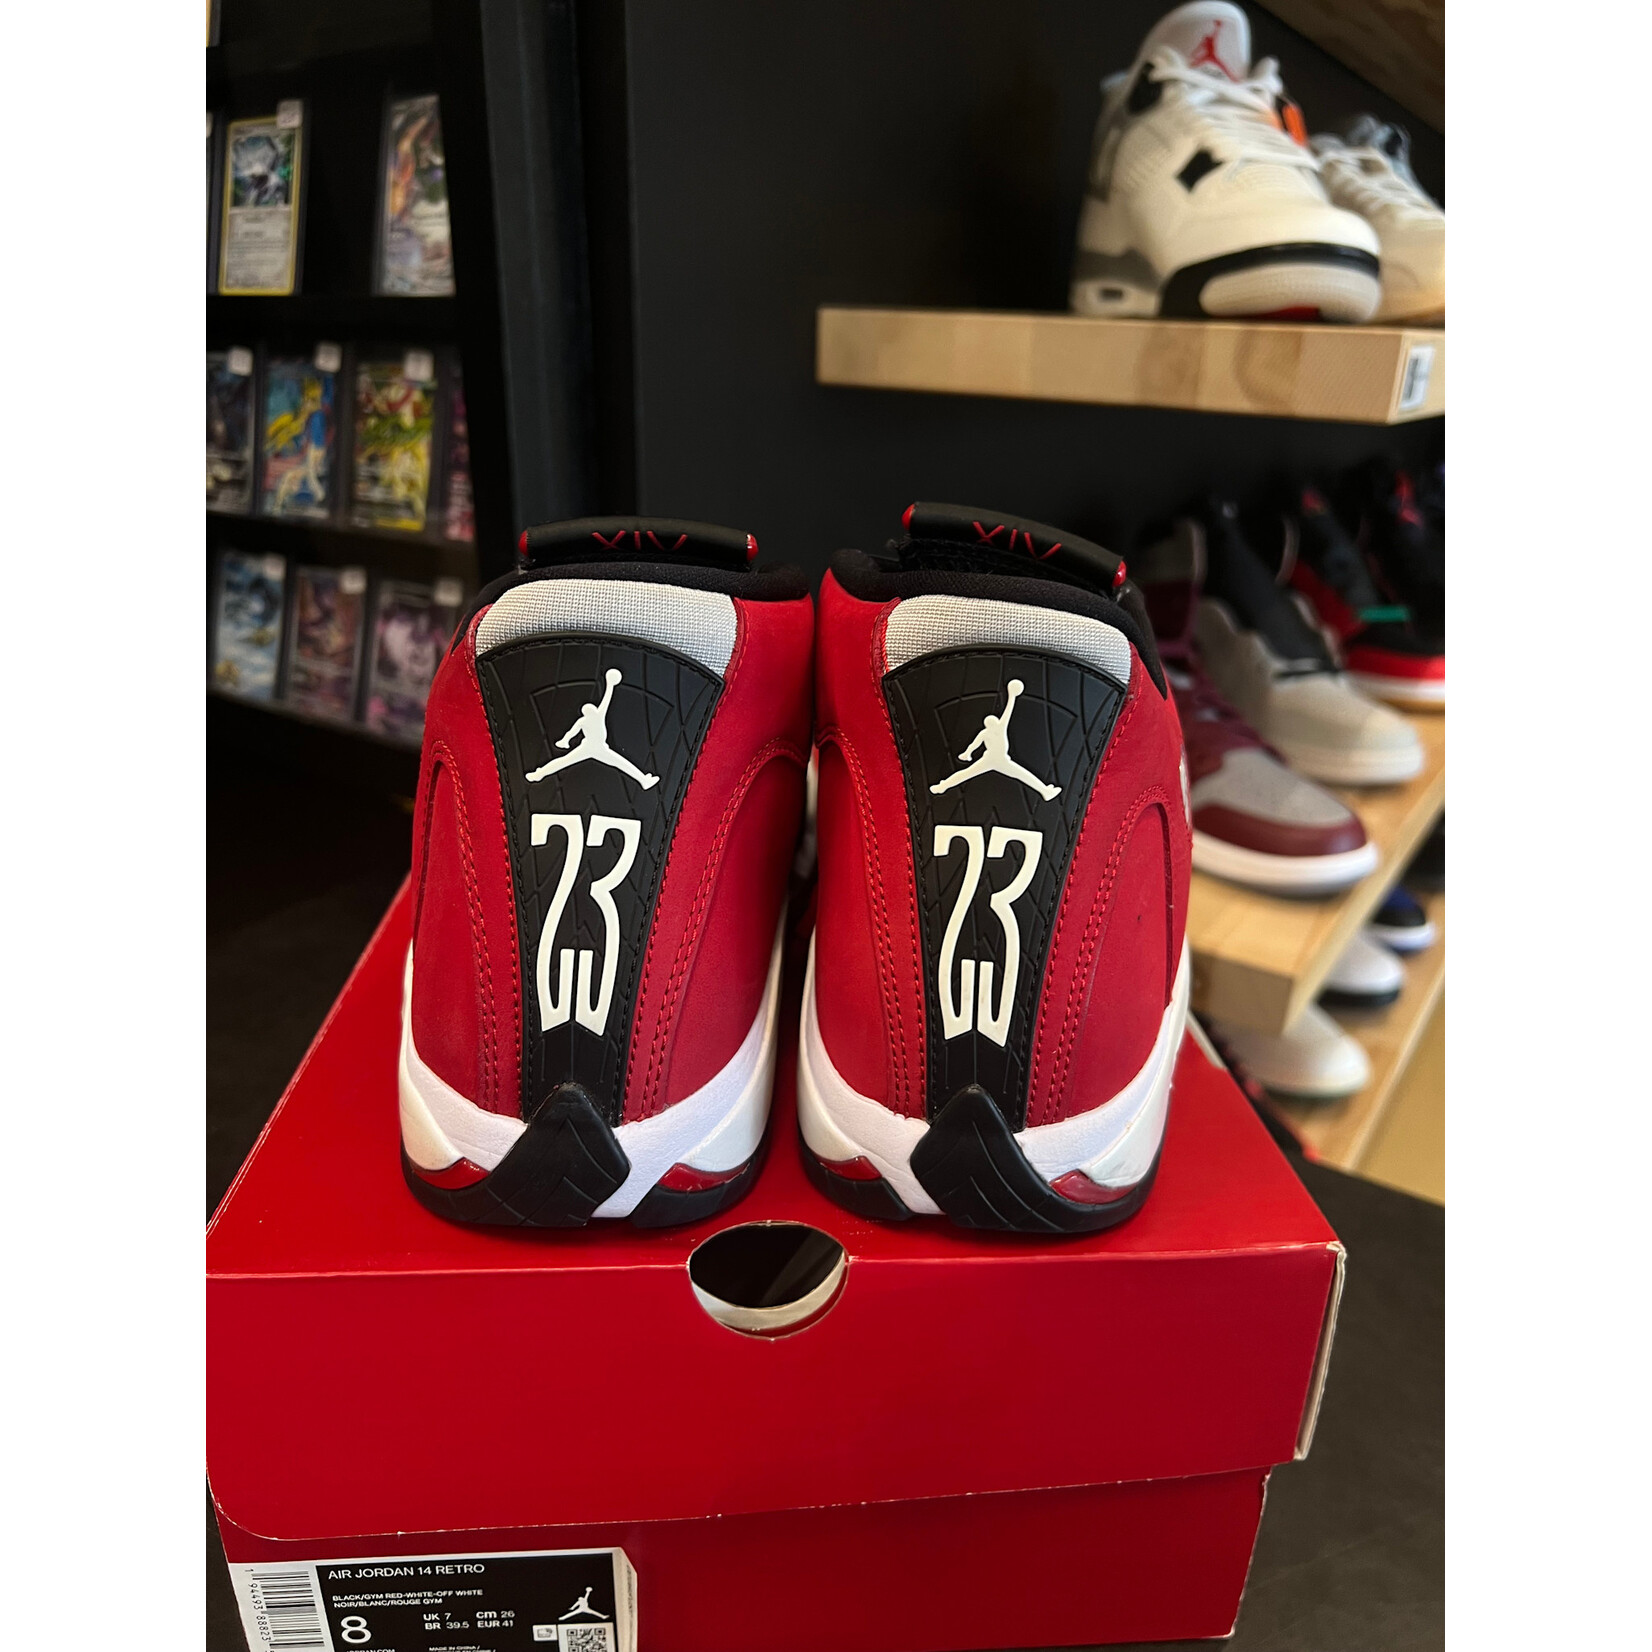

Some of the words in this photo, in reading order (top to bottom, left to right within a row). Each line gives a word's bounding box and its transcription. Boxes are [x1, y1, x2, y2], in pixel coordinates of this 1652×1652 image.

[591, 529, 689, 552] XIV
[972, 520, 1062, 561] XIV
[530, 812, 641, 1037] 23
[933, 824, 1043, 1048] 23
[328, 1569, 352, 1580] AIR
[355, 1566, 414, 1578] JORDAN
[418, 1566, 432, 1576] 14
[435, 1563, 485, 1575] RETRO
[332, 1593, 384, 1602] BLACK/GYM
[385, 1590, 454, 1599] RED-WHITE-OFF
[333, 1598, 421, 1608] NOIR/BLANC/ROUGE
[423, 1613, 440, 1621] UK
[444, 1612, 452, 1620] 7
[475, 1611, 497, 1619] cm
[500, 1610, 515, 1619] 26
[340, 1615, 372, 1644] 8
[424, 1622, 441, 1630] BR
[446, 1621, 470, 1629] 39.5
[477, 1620, 500, 1628] EUR
